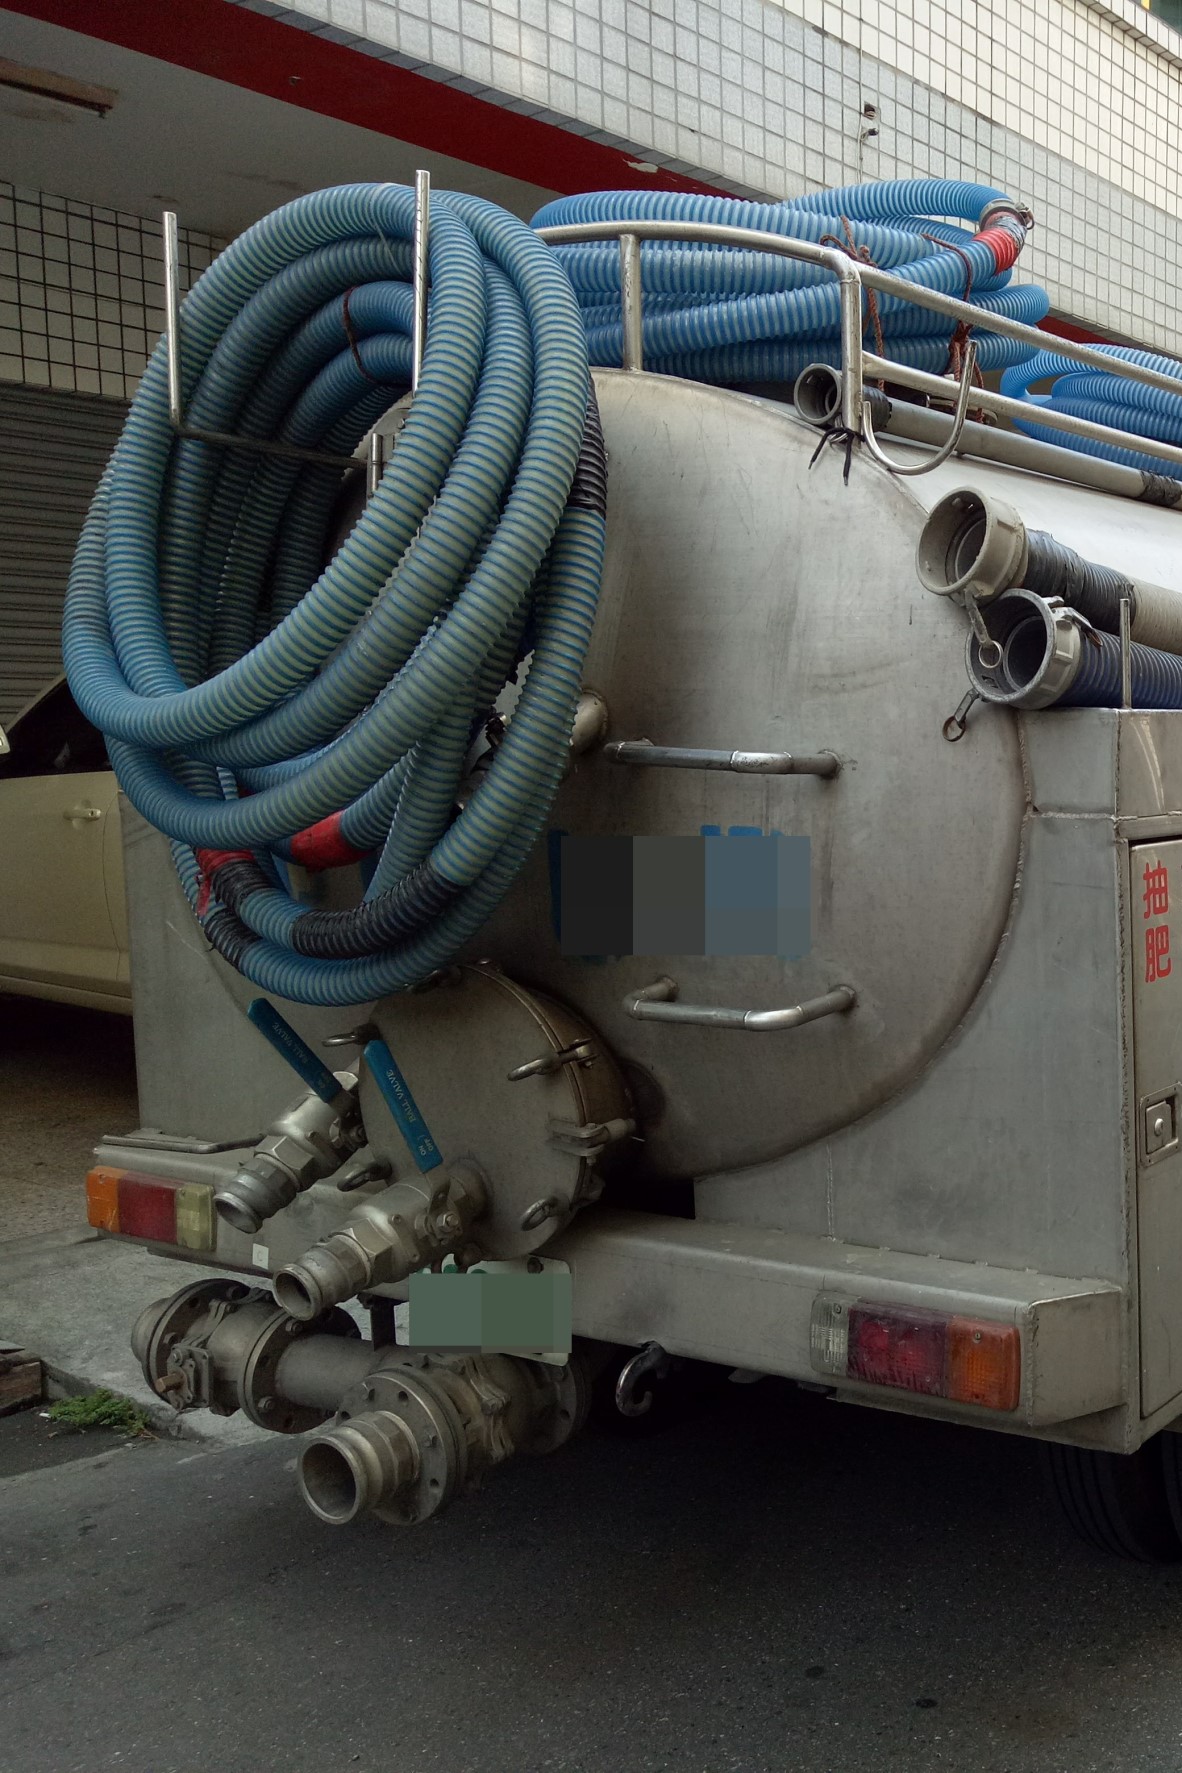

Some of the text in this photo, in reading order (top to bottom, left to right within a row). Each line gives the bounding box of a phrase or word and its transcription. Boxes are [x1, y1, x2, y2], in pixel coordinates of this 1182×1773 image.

[1143, 859, 1172, 983] 抽肥
[272, 1022, 293, 1047] VALVE
[386, 1069, 416, 1123] BALL VALVE
[418, 1145, 427, 1156] ON
